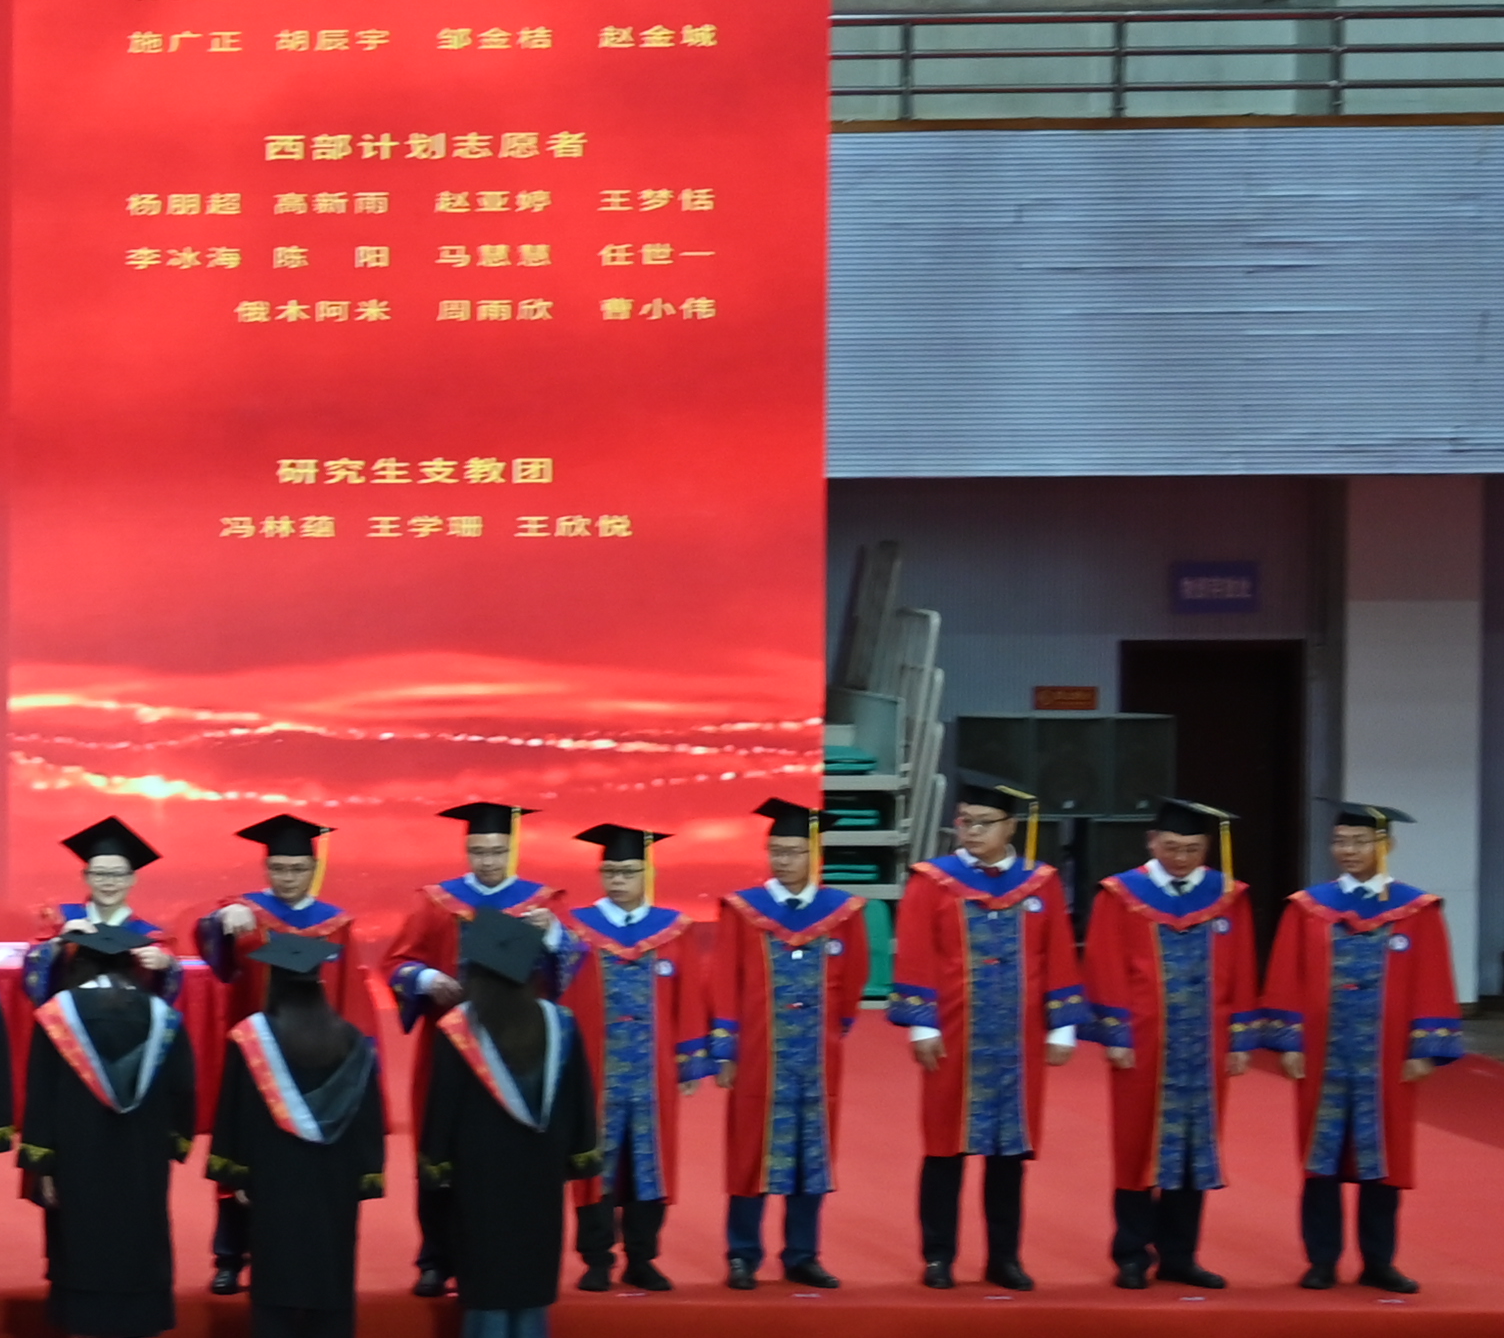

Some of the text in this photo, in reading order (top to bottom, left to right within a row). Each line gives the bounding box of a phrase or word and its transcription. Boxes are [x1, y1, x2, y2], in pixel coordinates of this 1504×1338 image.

[598, 24, 718, 48] 赵金城
[264, 131, 588, 161] 西部计划志愿者
[274, 191, 390, 215] 高新雨
[125, 246, 242, 270] 李冰海
[598, 243, 715, 266] 任世一
[436, 298, 554, 321] 周雨欣
[600, 296, 716, 320] 曹小伟
[277, 457, 553, 485] 研究生支教团
[514, 514, 633, 537] 王欣悦
